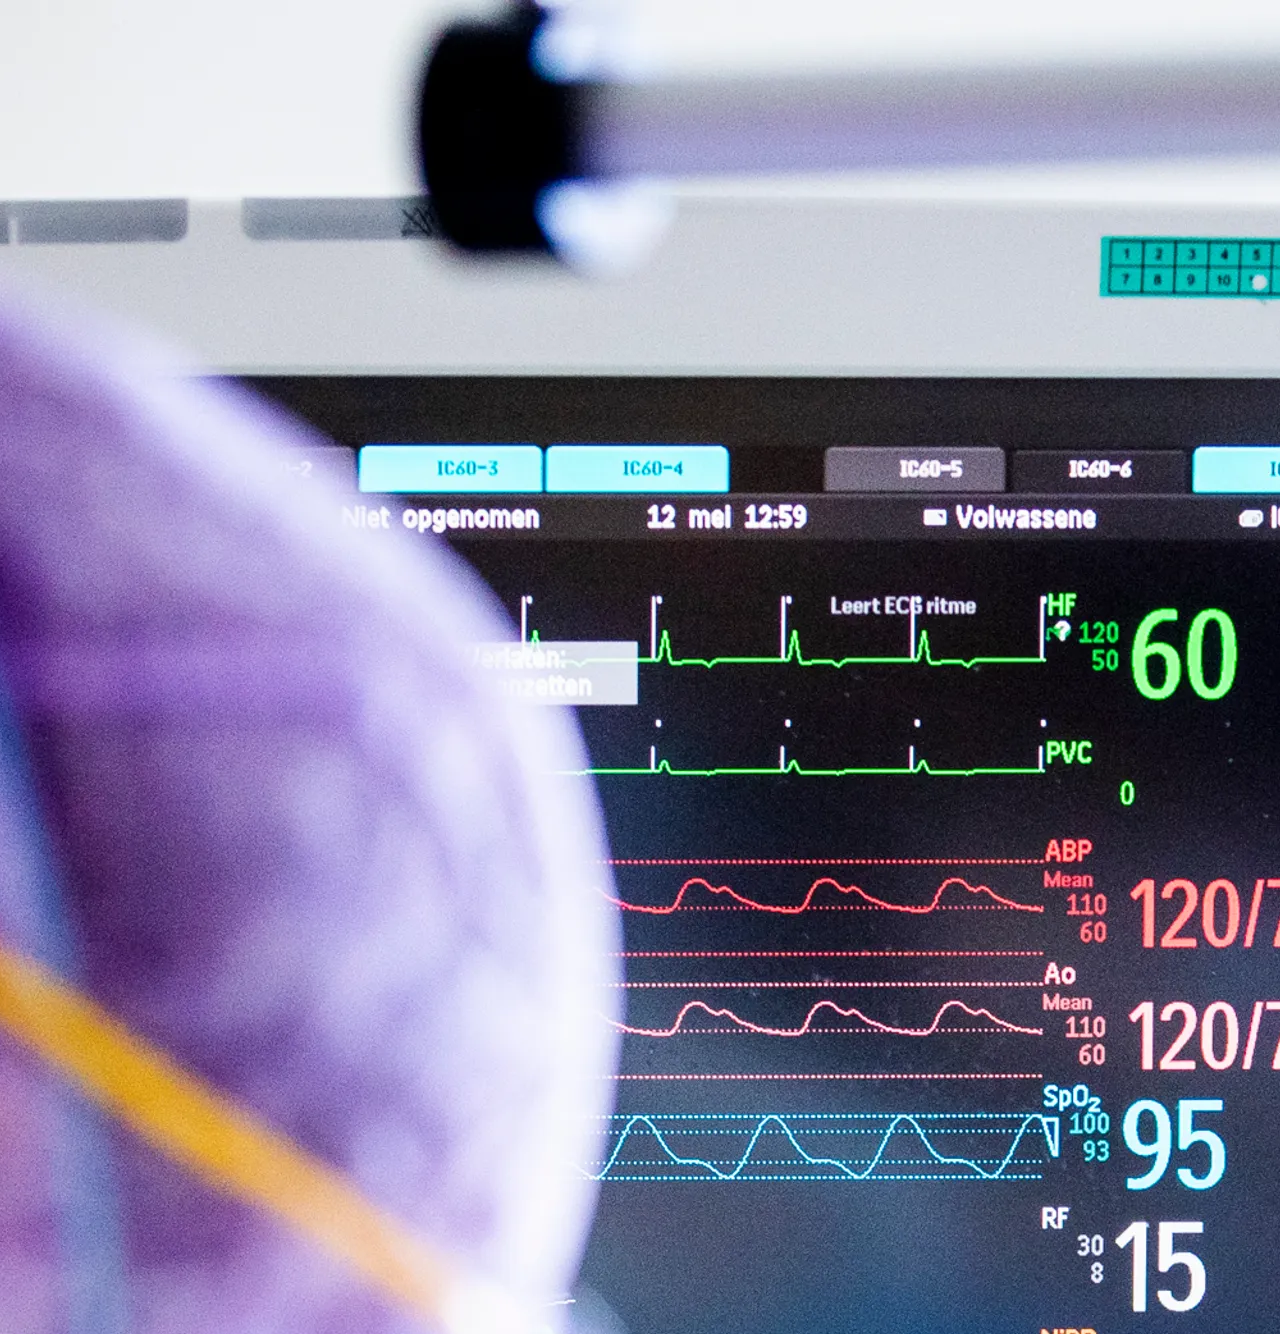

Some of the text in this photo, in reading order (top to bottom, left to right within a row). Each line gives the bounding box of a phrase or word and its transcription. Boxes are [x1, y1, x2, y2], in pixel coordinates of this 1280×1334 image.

[1217, 273, 1231, 287] 10
[437, 459, 499, 477] IC60-3
[622, 459, 684, 478] IC60-4
[899, 459, 963, 478] IC60-5
[1068, 459, 1132, 479] IC60-6
[402, 508, 540, 533] opgenomen
[647, 505, 807, 529] 12 mei 12:59
[955, 505, 1097, 531] Volwassene
[830, 596, 881, 616] Leert
[926, 596, 977, 616] ritme
[1047, 593, 1077, 616] HF
[1078, 621, 1120, 644] 120
[1091, 648, 1120, 672] 50
[1131, 608, 1238, 701] 60
[1046, 741, 1093, 765] PVC
[1119, 781, 1135, 806] 0
[1045, 839, 1093, 862] ABP
[1043, 870, 1094, 889] Mean
[1066, 893, 1108, 916] 110
[1079, 921, 1108, 944] 60
[1044, 962, 1077, 986] Ao
[1042, 992, 1093, 1012] Mean
[1065, 1016, 1107, 1039] 110
[1078, 1044, 1107, 1067] 60
[1068, 1112, 1110, 1135] 100
[1083, 1140, 1110, 1163] 93
[1122, 1098, 1227, 1191] 95
[1042, 1207, 1070, 1230] RF
[1077, 1235, 1105, 1257] 30
[1090, 1262, 1104, 1285] 8
[1115, 1221, 1207, 1313] 15
